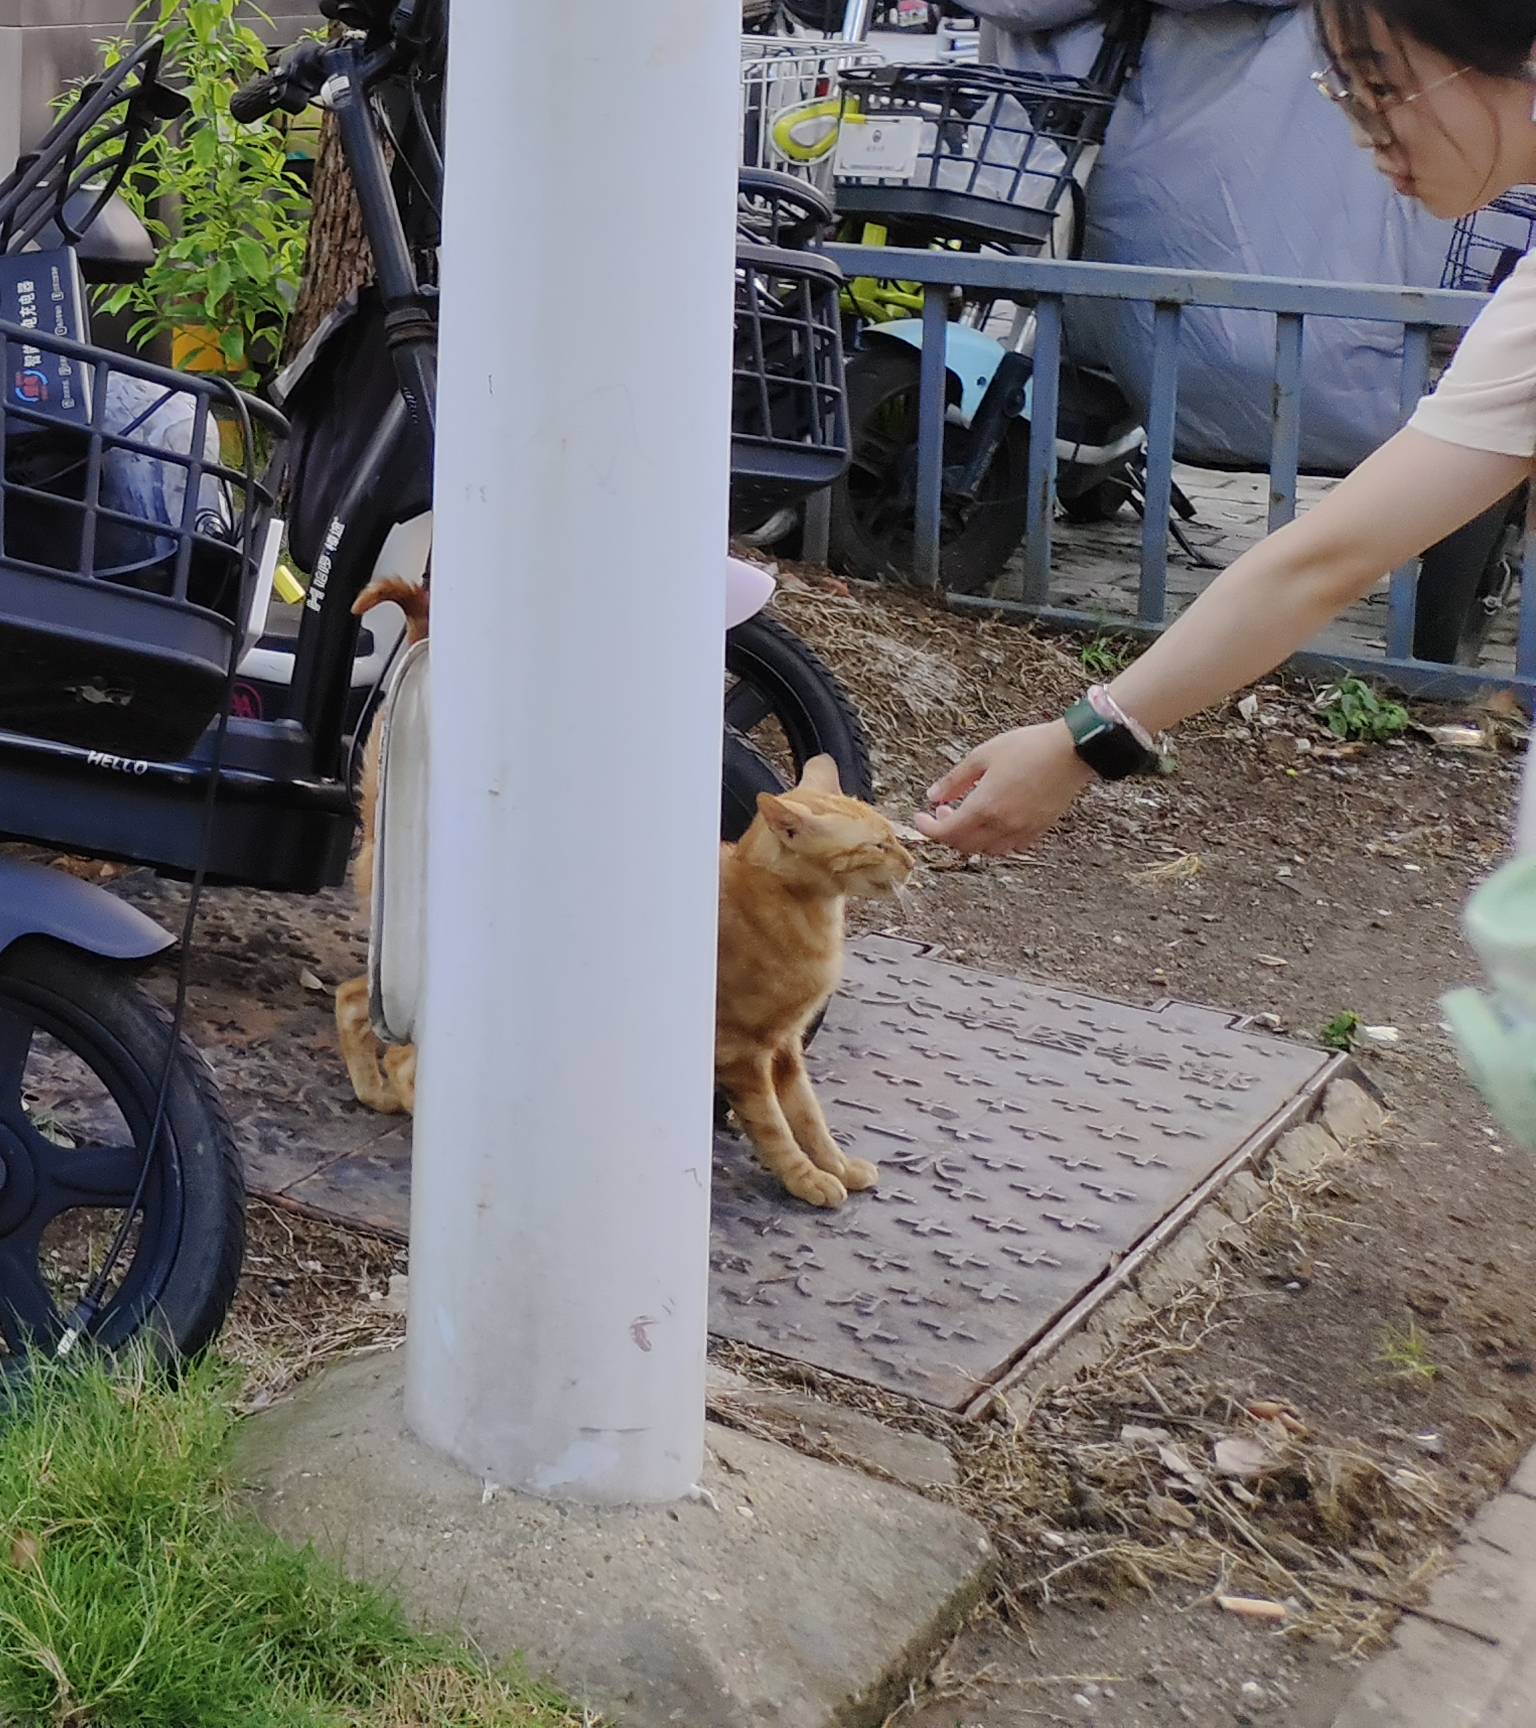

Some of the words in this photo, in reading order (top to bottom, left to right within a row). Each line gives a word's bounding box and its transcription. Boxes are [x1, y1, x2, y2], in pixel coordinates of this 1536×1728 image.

[16, 280, 43, 368] 智能电充电器
[87, 750, 149, 776] HELLO
